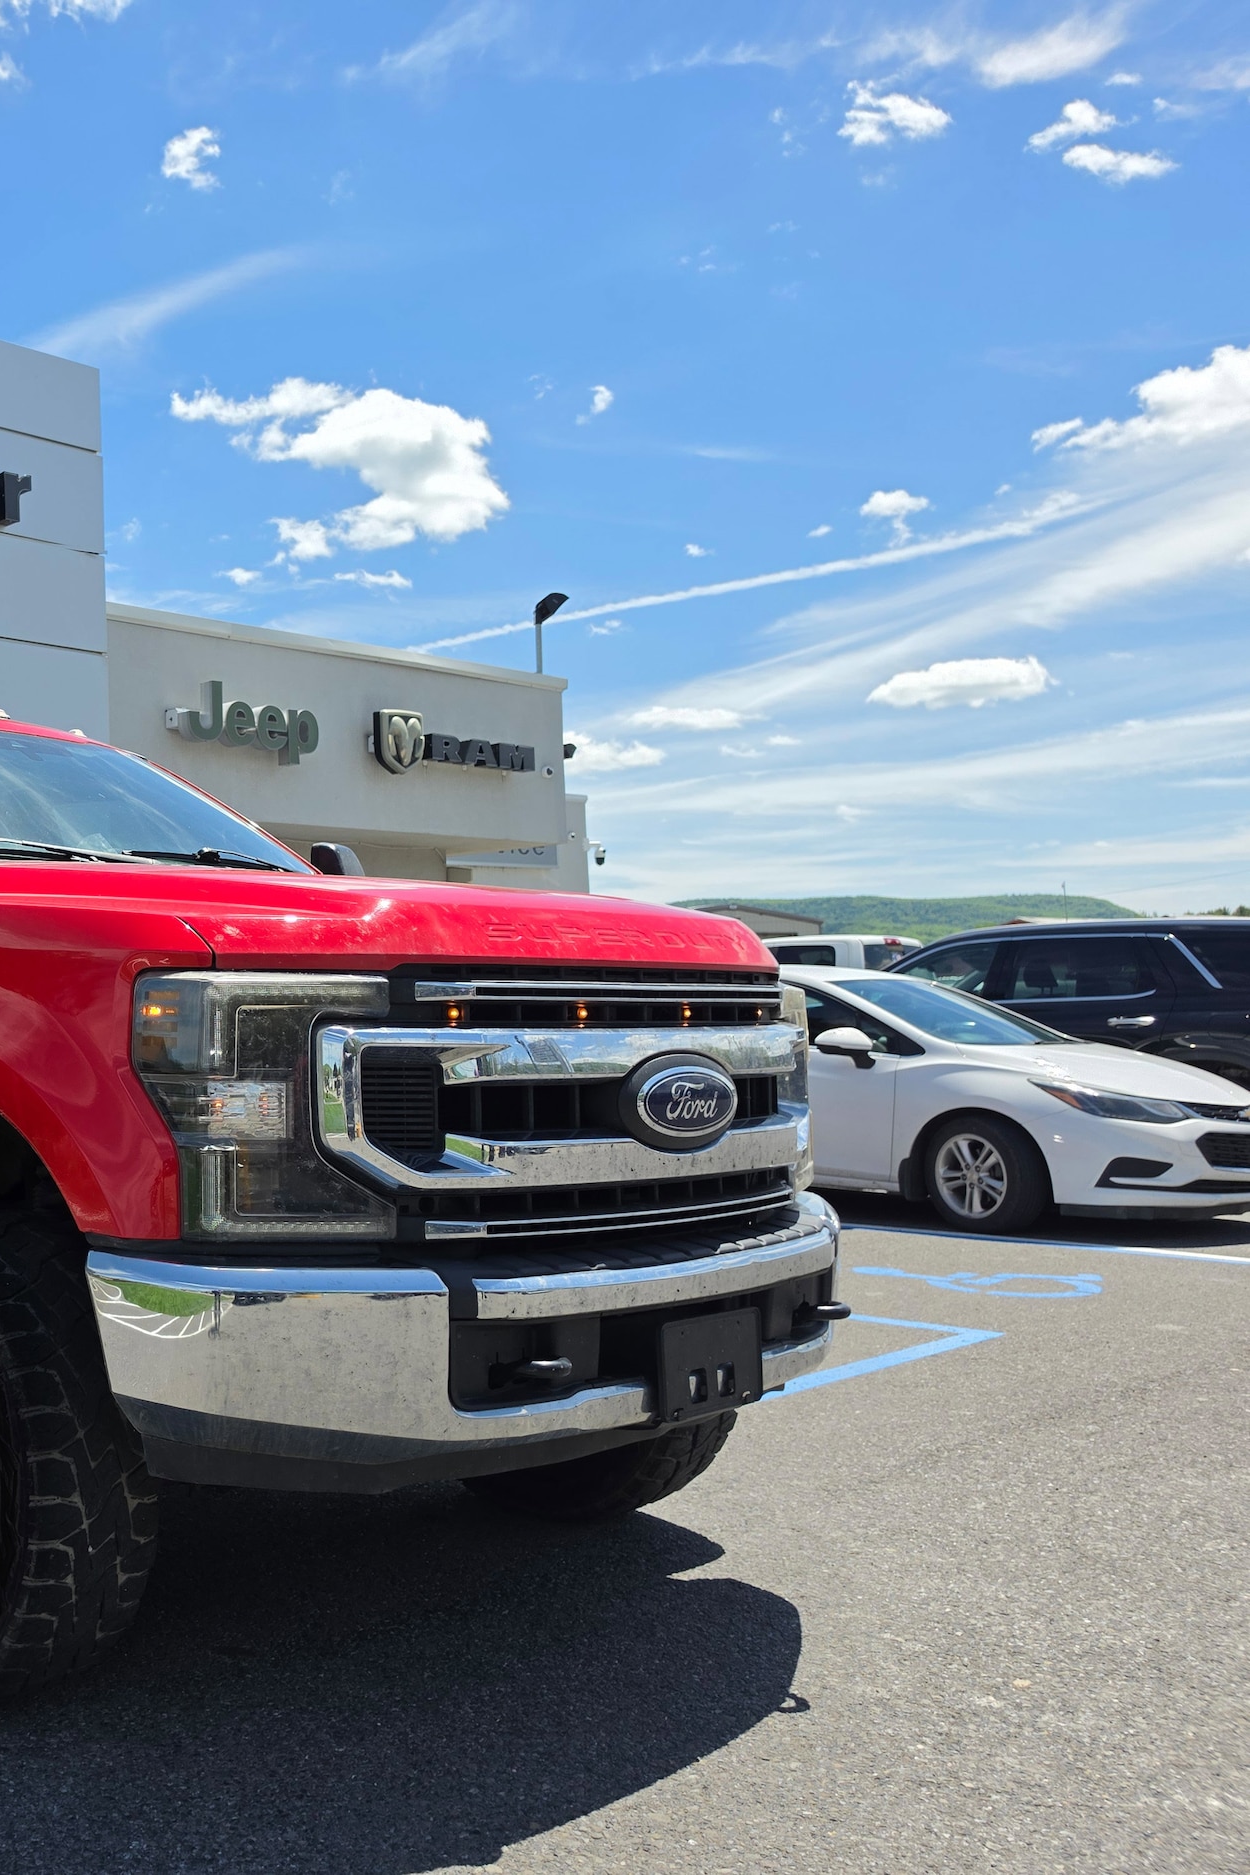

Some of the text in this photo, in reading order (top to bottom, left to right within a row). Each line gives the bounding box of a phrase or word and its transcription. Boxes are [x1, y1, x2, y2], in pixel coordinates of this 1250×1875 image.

[177, 680, 319, 766] Jeep
[424, 732, 535, 772] RAM
[485, 922, 747, 951] SUPER DUTY
[666, 1081, 718, 1120] Ford
